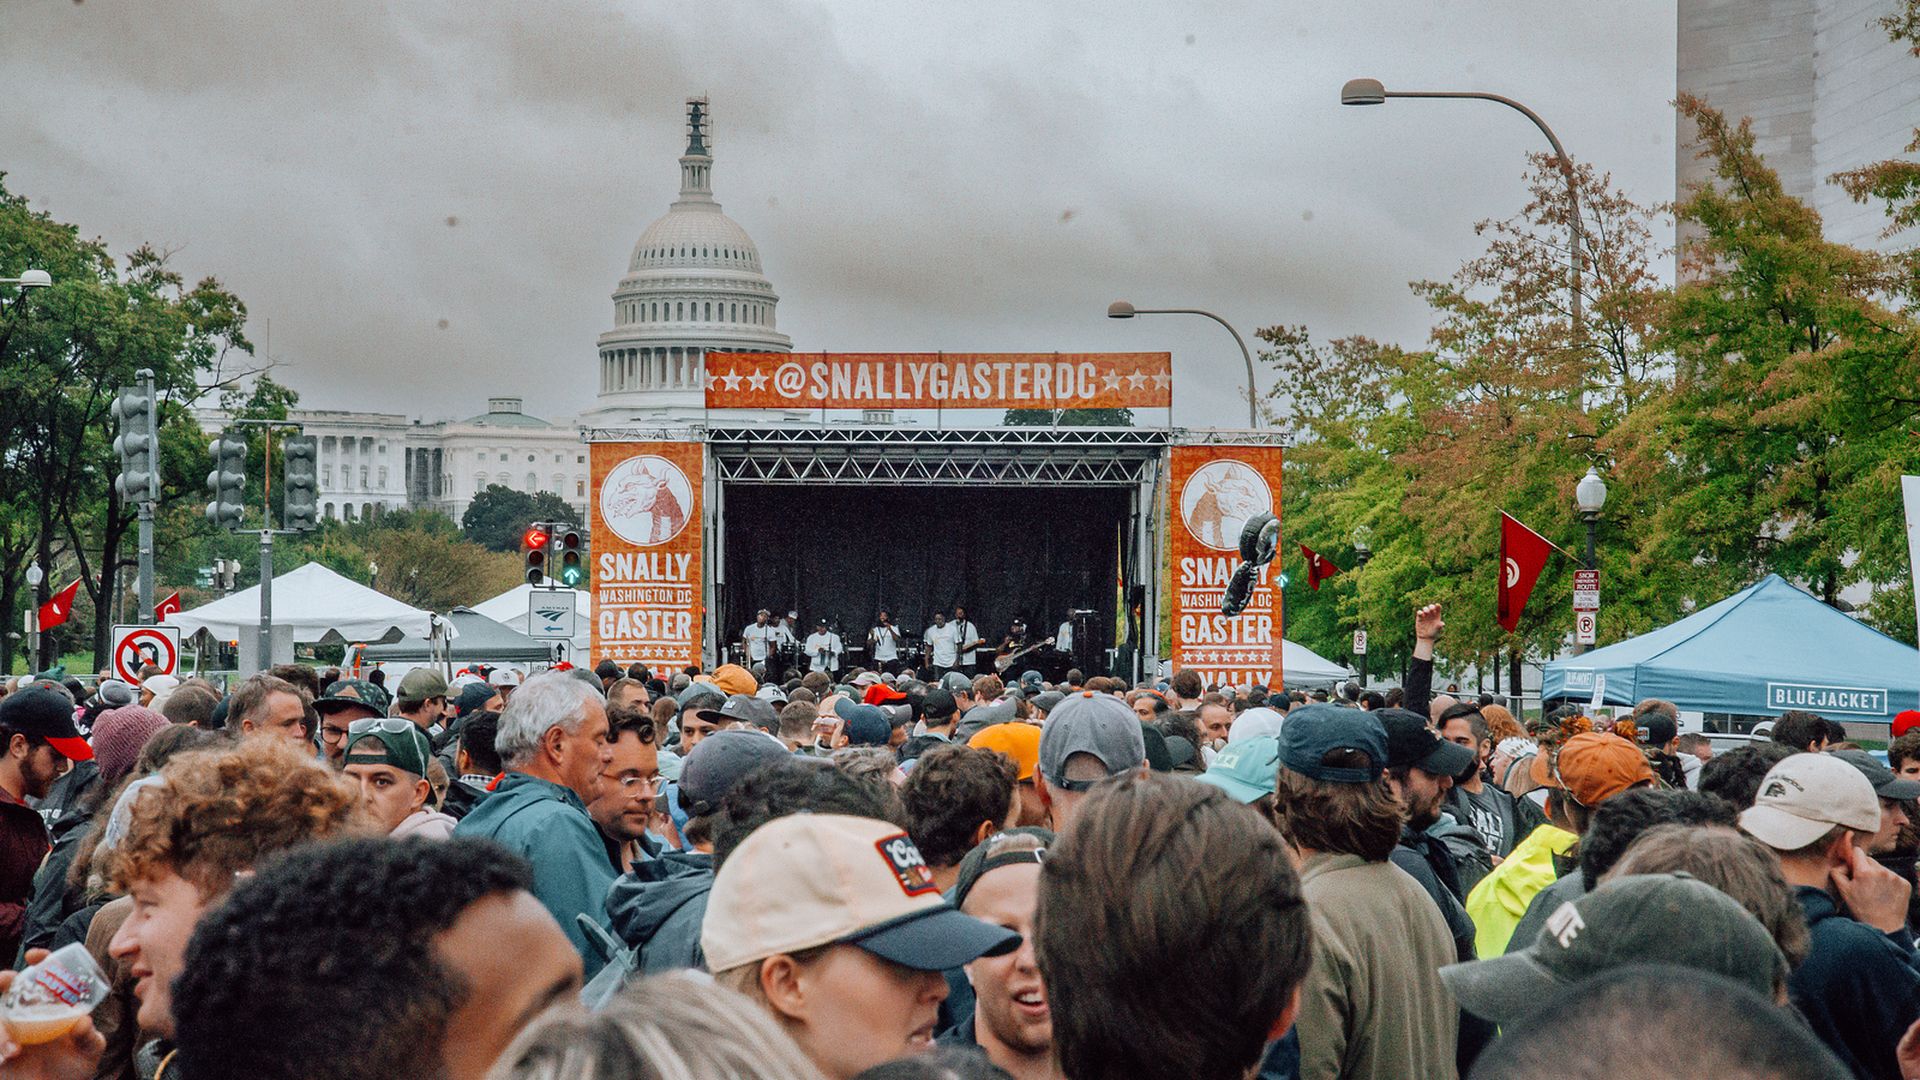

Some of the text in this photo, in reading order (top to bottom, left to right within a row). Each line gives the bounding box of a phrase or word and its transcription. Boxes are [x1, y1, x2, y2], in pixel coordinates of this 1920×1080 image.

[774, 361, 1096, 400] @SNALLYGASTERDC
[599, 552, 691, 581] SNALLY
[1180, 557, 1271, 586] SNAY
[600, 589, 692, 603] WASHINGTON DC
[1258, 593, 1272, 607] DC
[600, 610, 692, 640] GASTER
[1181, 615, 1272, 643] GASTER
[1775, 688, 1880, 709] BLUEJACKET
